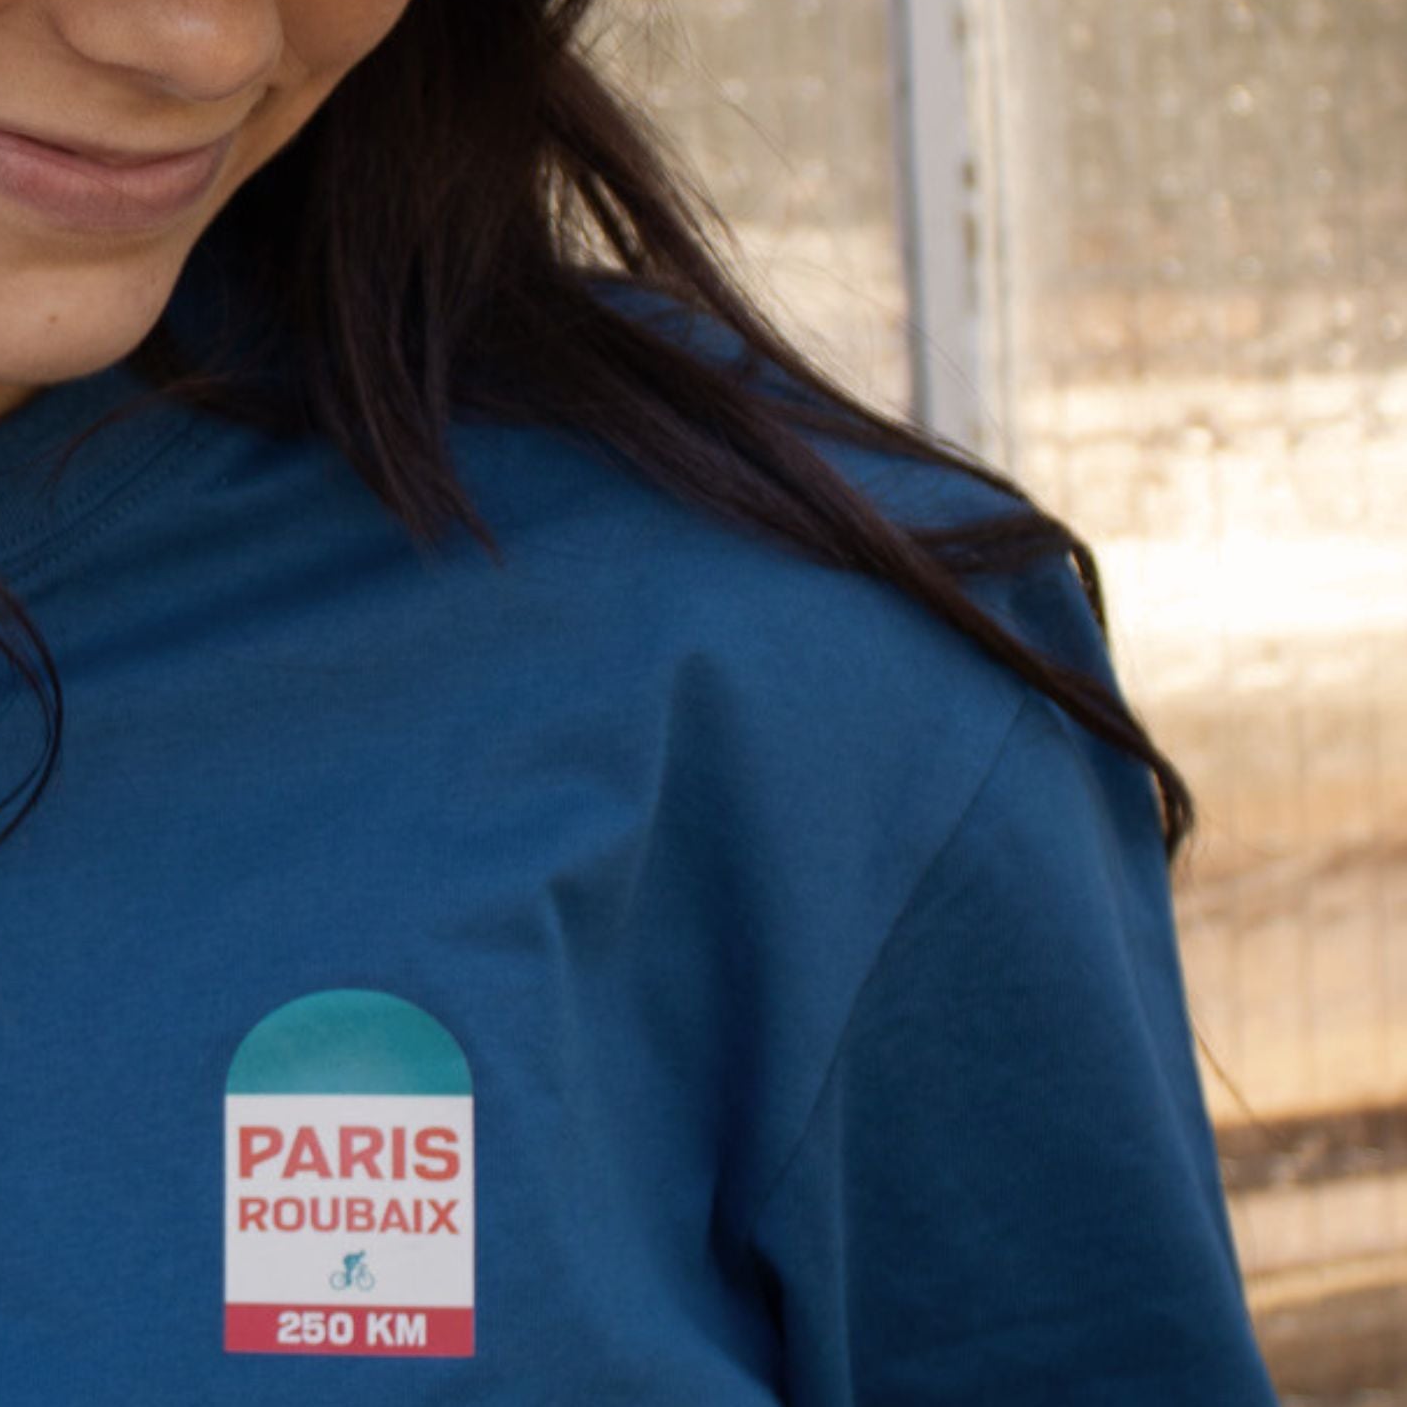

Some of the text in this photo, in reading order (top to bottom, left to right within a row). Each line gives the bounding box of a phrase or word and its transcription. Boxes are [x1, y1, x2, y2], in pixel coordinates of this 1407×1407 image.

[237, 1125, 461, 1182] PARIS
[238, 1197, 459, 1234] ROUBAIX
[276, 1310, 427, 1347] 250 KM
